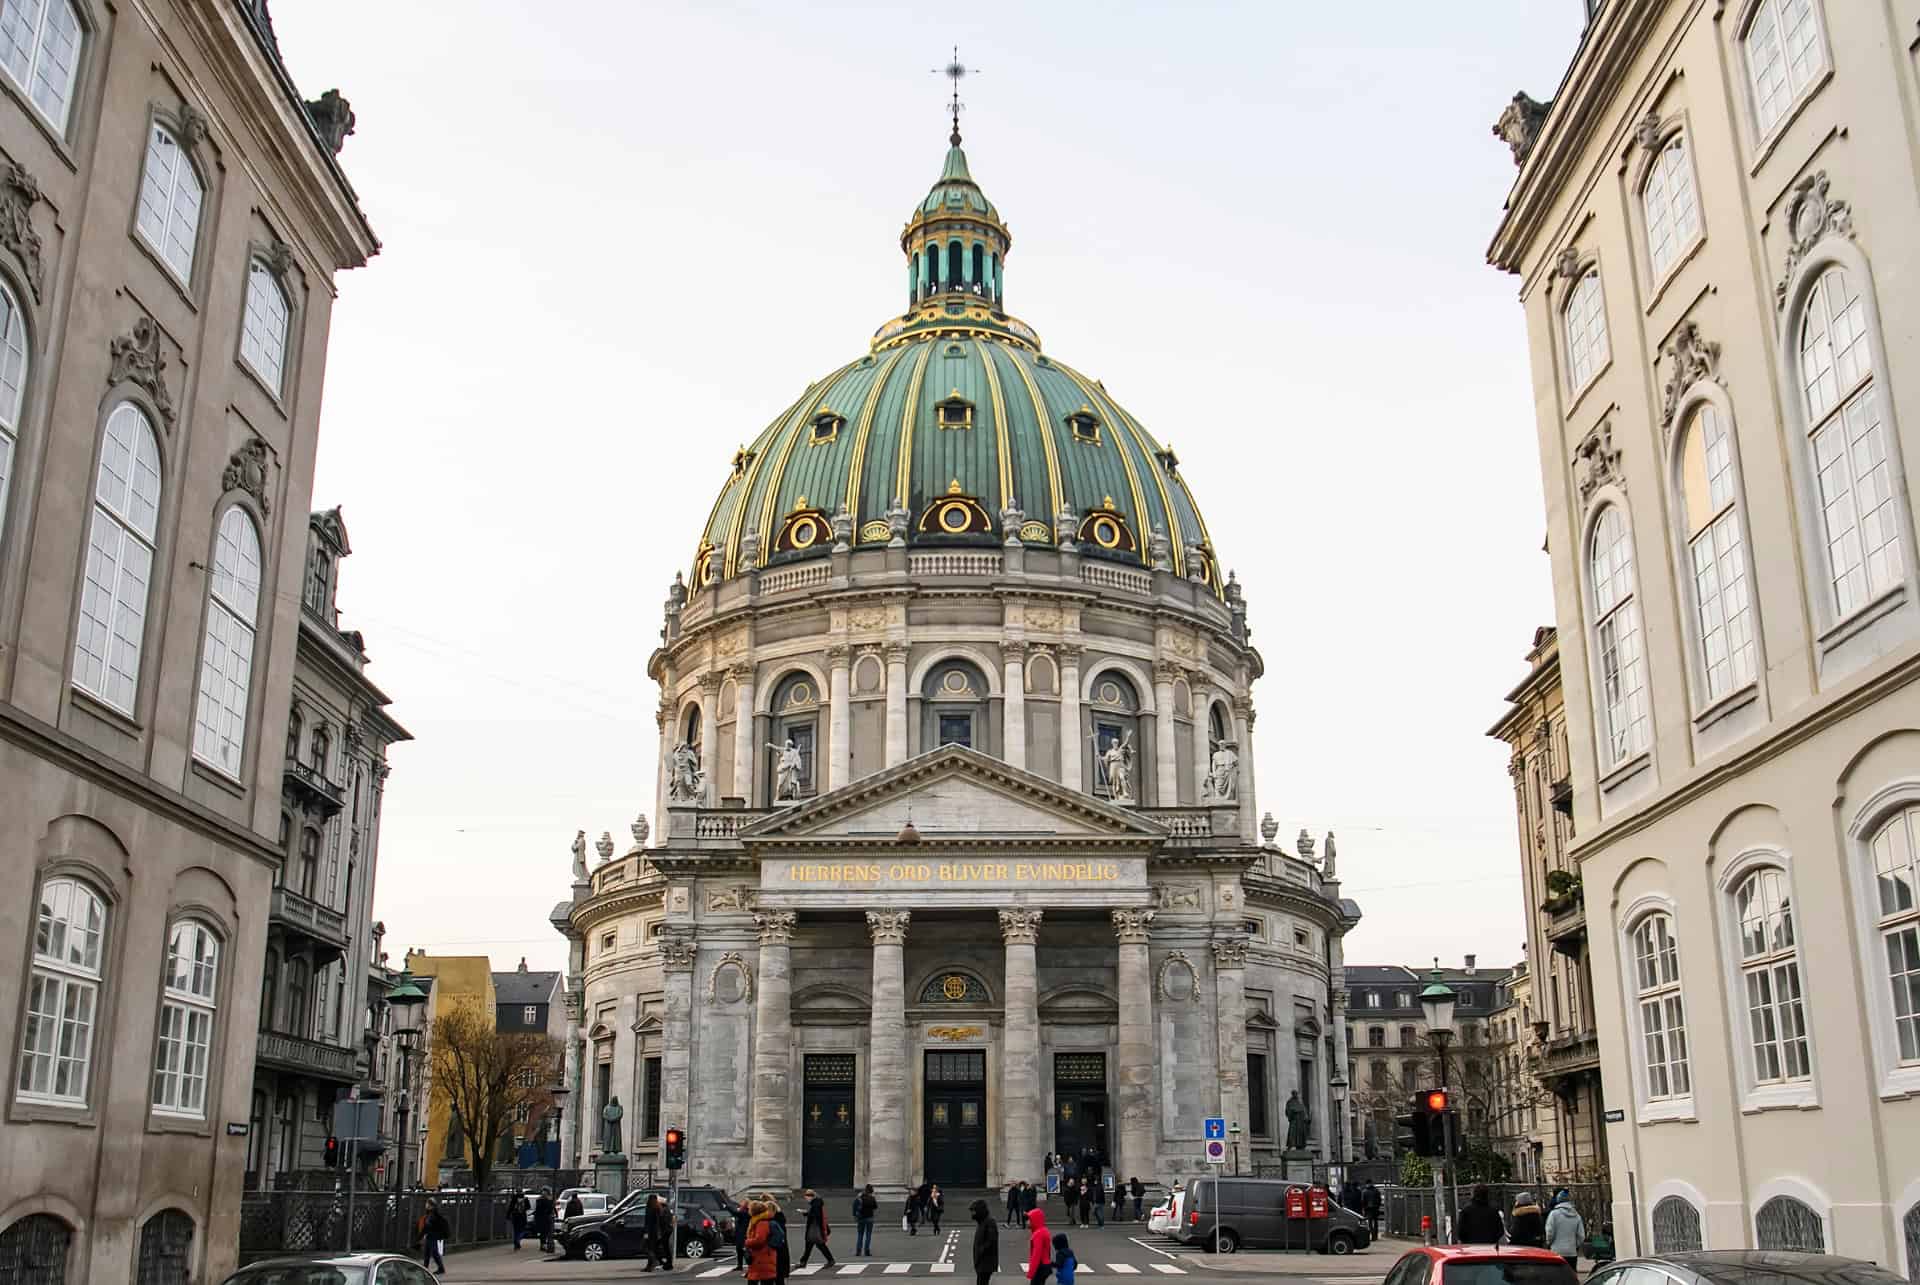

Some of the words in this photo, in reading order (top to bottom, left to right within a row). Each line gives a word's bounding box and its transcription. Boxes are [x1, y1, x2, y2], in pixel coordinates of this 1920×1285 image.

[791, 864, 881, 881] HERRENS
[888, 864, 931, 881] ORD
[939, 864, 1009, 881] BLIVER
